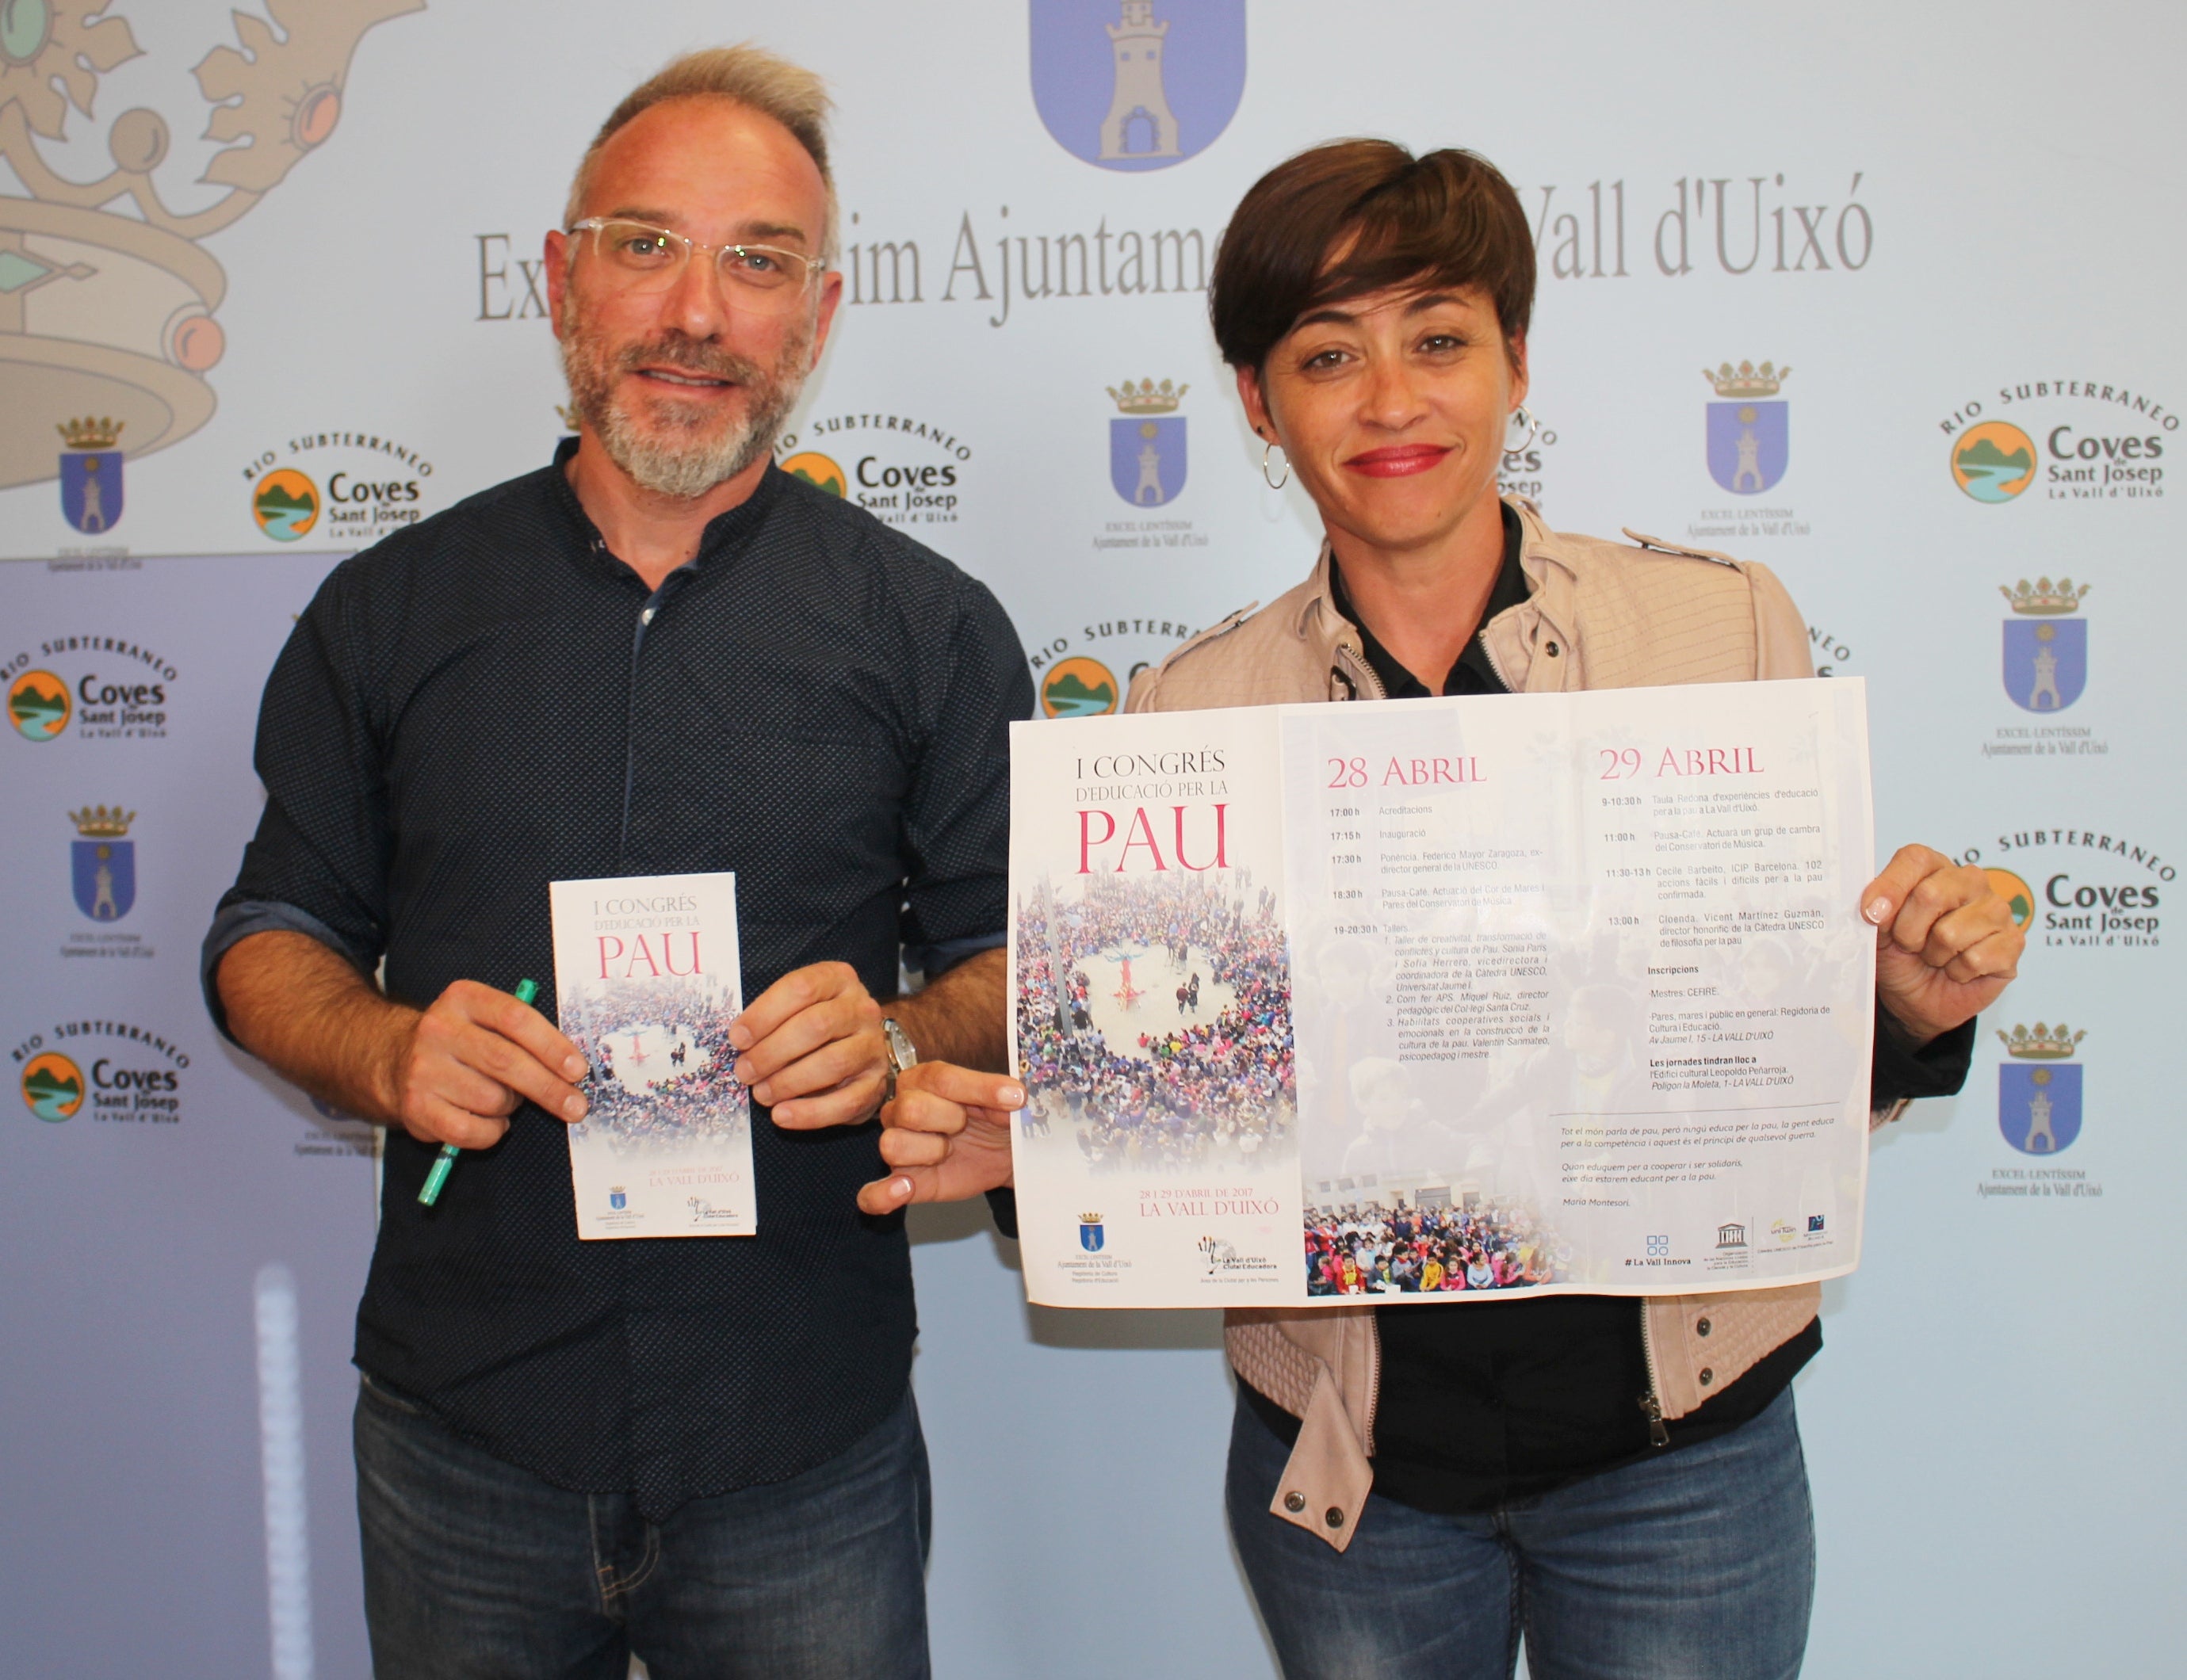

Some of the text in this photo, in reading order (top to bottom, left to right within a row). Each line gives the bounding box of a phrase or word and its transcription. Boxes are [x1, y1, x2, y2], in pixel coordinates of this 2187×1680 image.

[942, 203, 1211, 328] Ajuntam
[1654, 171, 1874, 277] d'Uixó
[1940, 380, 2179, 434] RIO SUBTERRANEO
[814, 414, 971, 461] SUBTERRANEO
[2048, 425, 2163, 460] Coves
[243, 433, 433, 480] RIO SUBTERRANEO
[857, 456, 957, 487] Coves
[2048, 464, 2162, 485] Sant Josep
[329, 472, 419, 502] Coves
[2049, 487, 2102, 498] La Vall
[857, 493, 957, 510] Sant Josep
[329, 507, 420, 524] Sant Josep
[0, 636, 177, 682] RIO SUBTERRANEO
[1031, 638, 1068, 669] RIO
[79, 675, 165, 704] Coves
[79, 708, 166, 726] Sant Josep
[1094, 746, 1225, 779] CONGRÉS
[1328, 756, 1487, 788] 28 ABRIL
[1600, 747, 1765, 781] 29 ABRIL
[1076, 780, 1229, 802] D'EDUCACIÓ PER LA
[1330, 805, 1432, 817] 17:00 Acreditacions
[1601, 797, 1635, 806] 9-10:30
[1076, 804, 1232, 874] PAU
[1379, 830, 1426, 839] Inauguració
[1999, 830, 2176, 881] SUBTERRANEO
[1606, 861, 1822, 877] 11:30-13 102
[1332, 891, 1357, 899] 18:30
[2046, 874, 2159, 907] Coves
[606, 892, 698, 914] CONGRÉS
[1608, 917, 1633, 926] 13:00
[1704, 912, 1733, 922] Vicent
[1788, 920, 1824, 930] UNESCO
[2046, 914, 2159, 934] Sant Josep
[1335, 926, 1371, 934] 19-20:30
[2047, 937, 2063, 946] La
[2070, 936, 2099, 945] Vall
[597, 932, 702, 979] PAU
[1648, 966, 1699, 976] Inscripcions
[12, 1021, 189, 1068] RIO SUBTERRANEO
[1666, 1058, 1702, 1068] jornades
[1704, 1056, 1734, 1065] tindran
[92, 1059, 178, 1090] Coves
[93, 1093, 178, 1111] Sant Josep
[1606, 1128, 1627, 1137] parla
[1642, 1128, 1659, 1138] pau,
[1662, 1126, 1680, 1136] però
[1736, 1124, 1749, 1133] per
[1761, 1122, 1779, 1132] pau,
[1791, 1120, 1809, 1130] gent
[1811, 1117, 1834, 1126] educa
[1561, 1140, 1574, 1149] per
[1654, 1138, 1680, 1148] aquest
[1703, 1136, 1734, 1146] principi
[1737, 1134, 1745, 1143] de
[1749, 1133, 1786, 1144] qualsevol
[1587, 1163, 1624, 1174] eduquem
[1627, 1164, 1641, 1174] per
[1651, 1163, 1685, 1172] cooperar
[1631, 1174, 1662, 1182] educant
[649, 1178, 663, 1187] LA
[667, 1177, 694, 1186] VALL
[1139, 1190, 1150, 1199] 28
[1233, 1188, 1253, 1197] 2017
[1140, 1198, 1279, 1218] LA VALL D'UIXÓ
